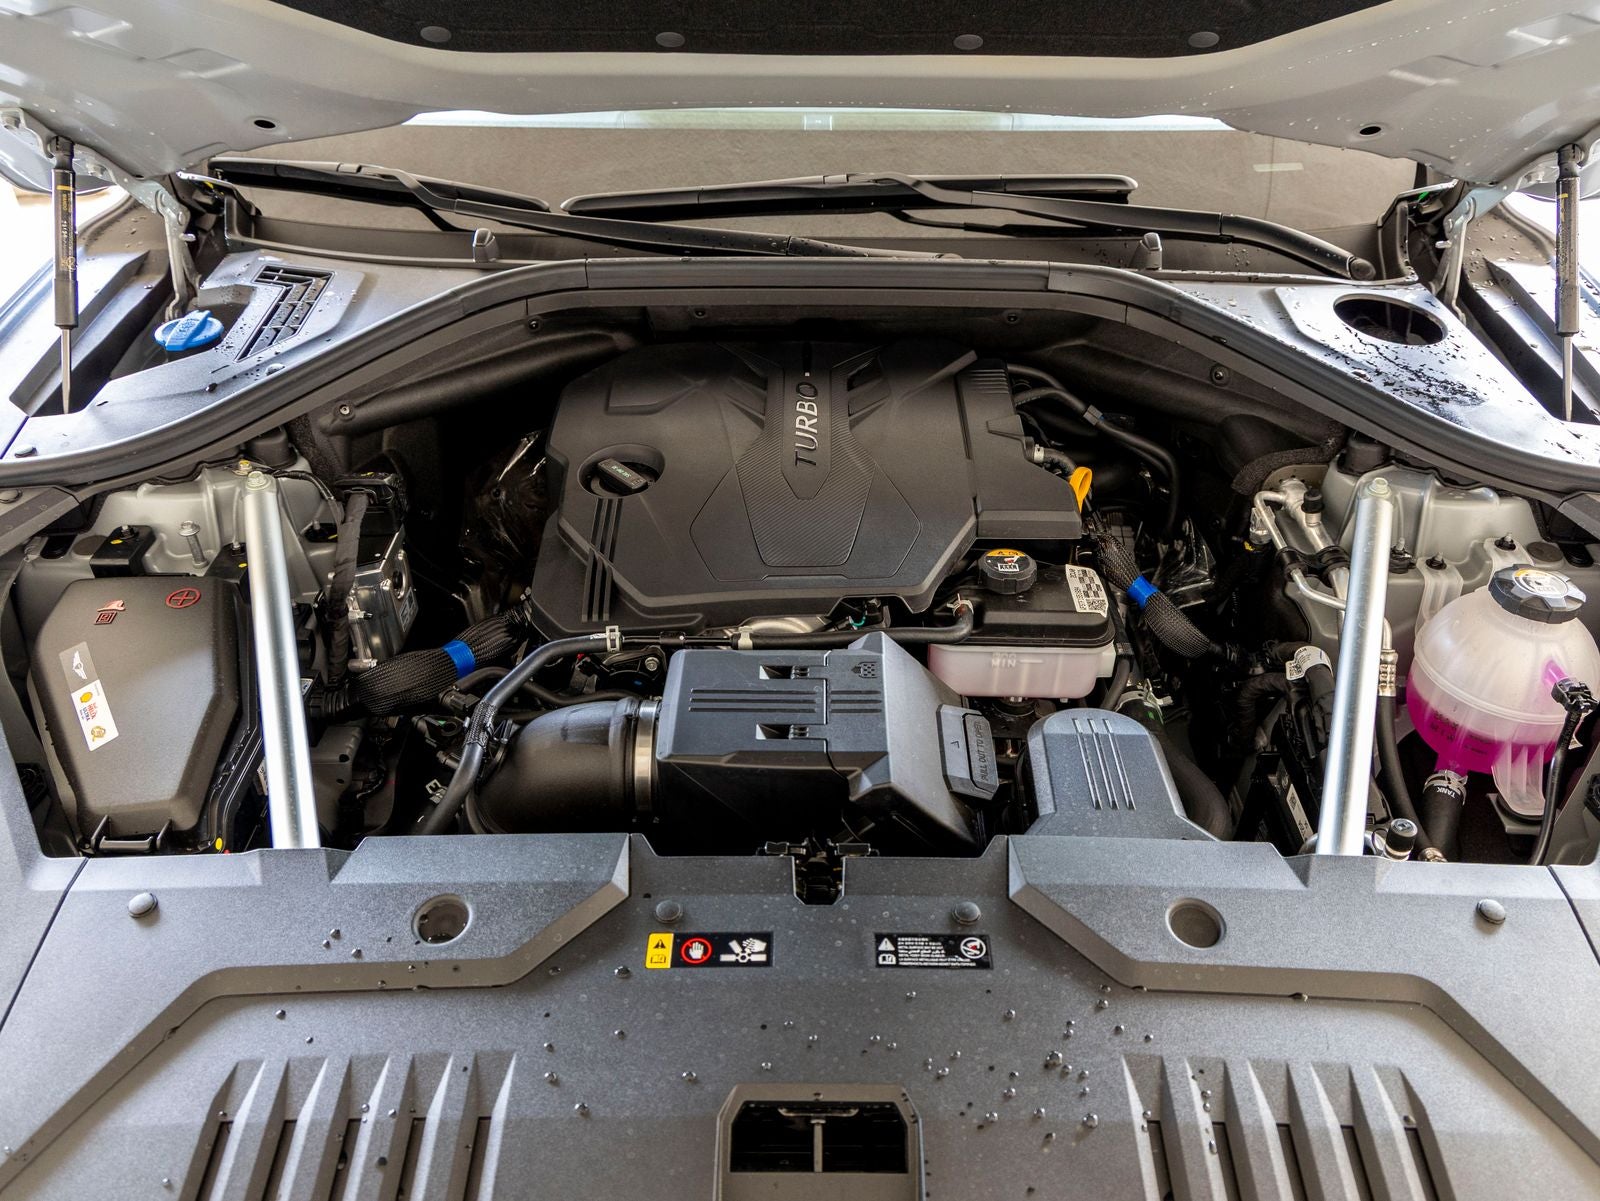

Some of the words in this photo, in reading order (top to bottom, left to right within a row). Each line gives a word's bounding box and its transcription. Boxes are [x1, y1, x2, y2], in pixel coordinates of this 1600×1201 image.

[795, 381, 818, 467] TURBO
[976, 738, 983, 748] TO
[977, 749, 986, 762] OUT
[1437, 787, 1456, 799] TANK
